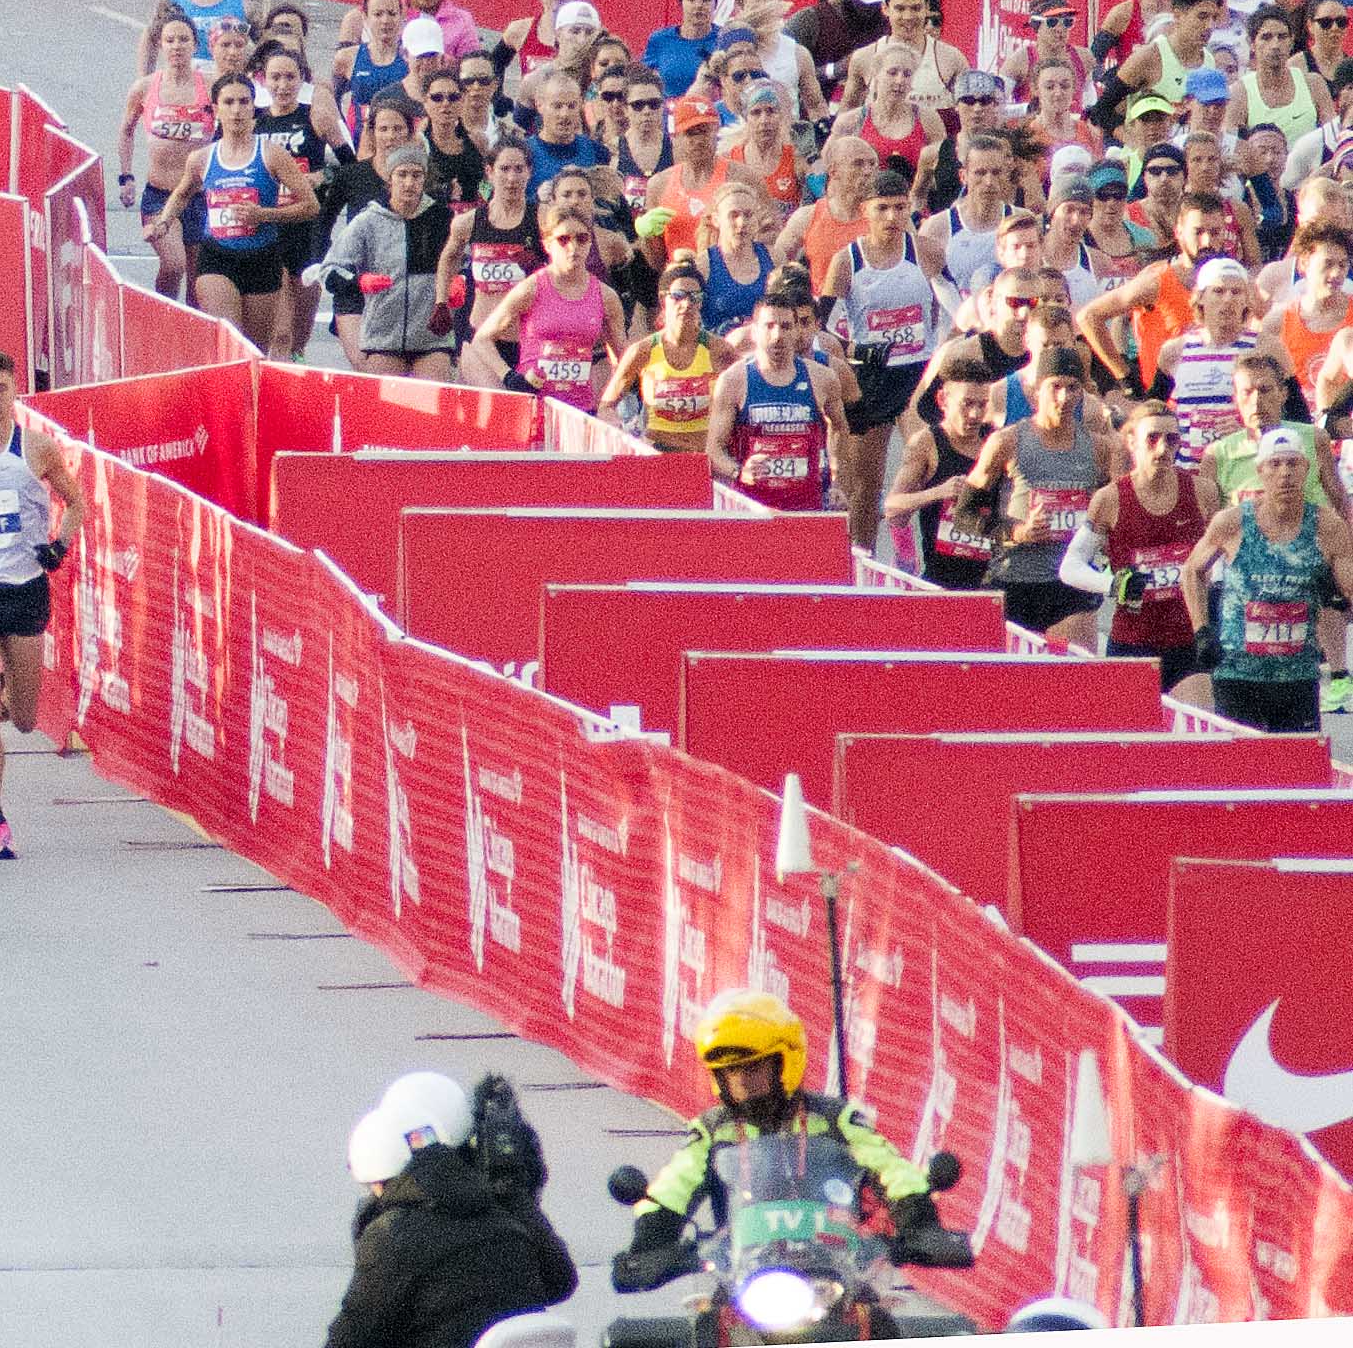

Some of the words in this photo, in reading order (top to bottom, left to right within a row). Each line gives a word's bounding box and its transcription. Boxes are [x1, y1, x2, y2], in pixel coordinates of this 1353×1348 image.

[161, 123, 191, 138] 578
[480, 262, 514, 281] 666
[881, 326, 916, 344] 568
[548, 362, 582, 380] 459
[664, 398, 697, 412] 521
[764, 1209, 804, 1232] TV
